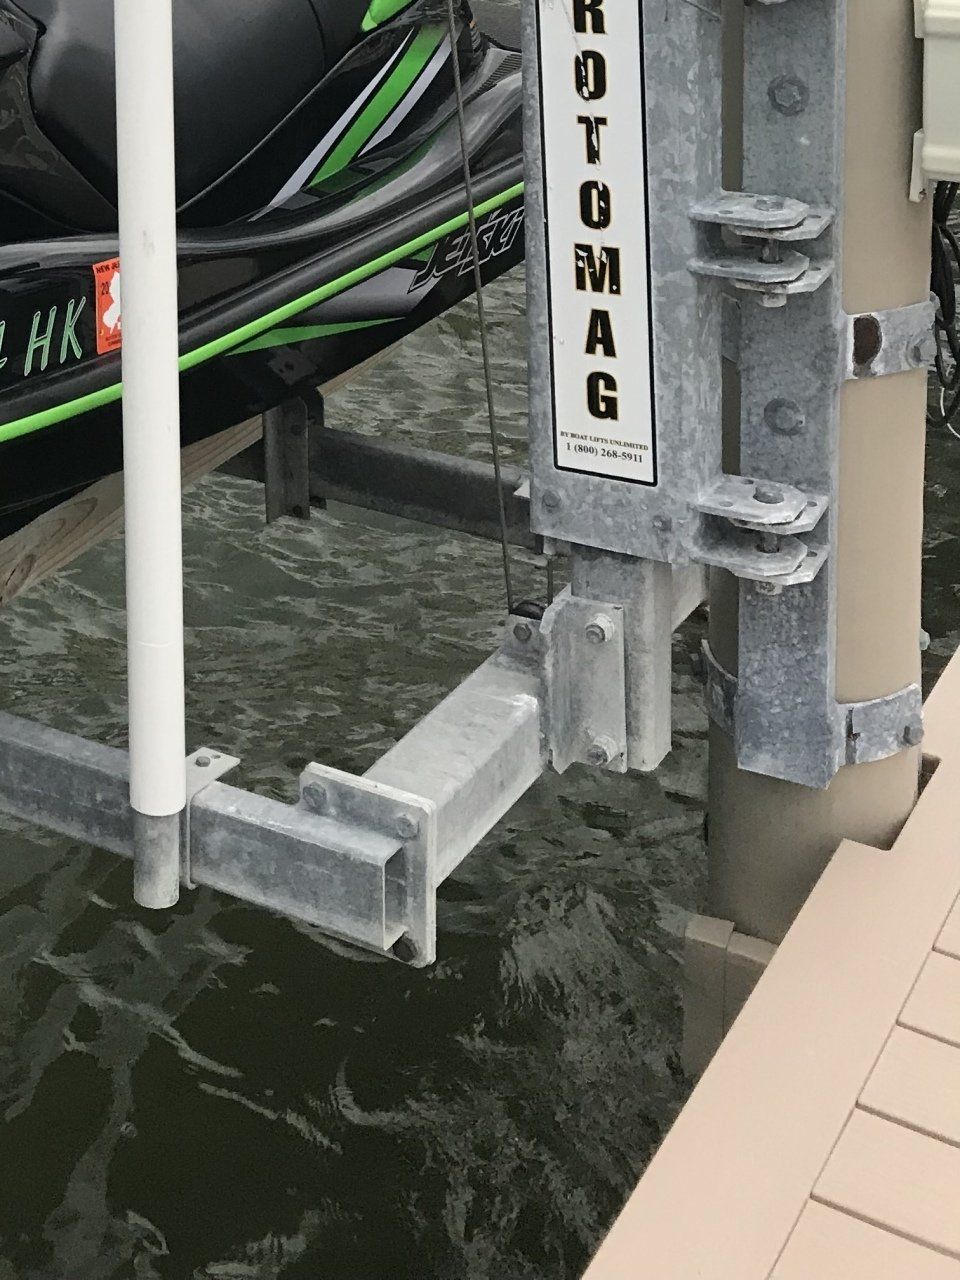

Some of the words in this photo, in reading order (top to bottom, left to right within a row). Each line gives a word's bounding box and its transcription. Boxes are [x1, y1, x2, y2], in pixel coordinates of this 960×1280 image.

[96, 263, 110, 274] NEW
[24, 296, 87, 377] HK
[560, 430, 569, 438] BY
[570, 432, 588, 441] BOAT
[589, 435, 609, 444] LIFTS
[609, 439, 649, 451] UNLIMITED
[566, 442, 571, 451] 1
[574, 443, 598, 457] (800)
[601, 448, 643, 463] 268-5911
